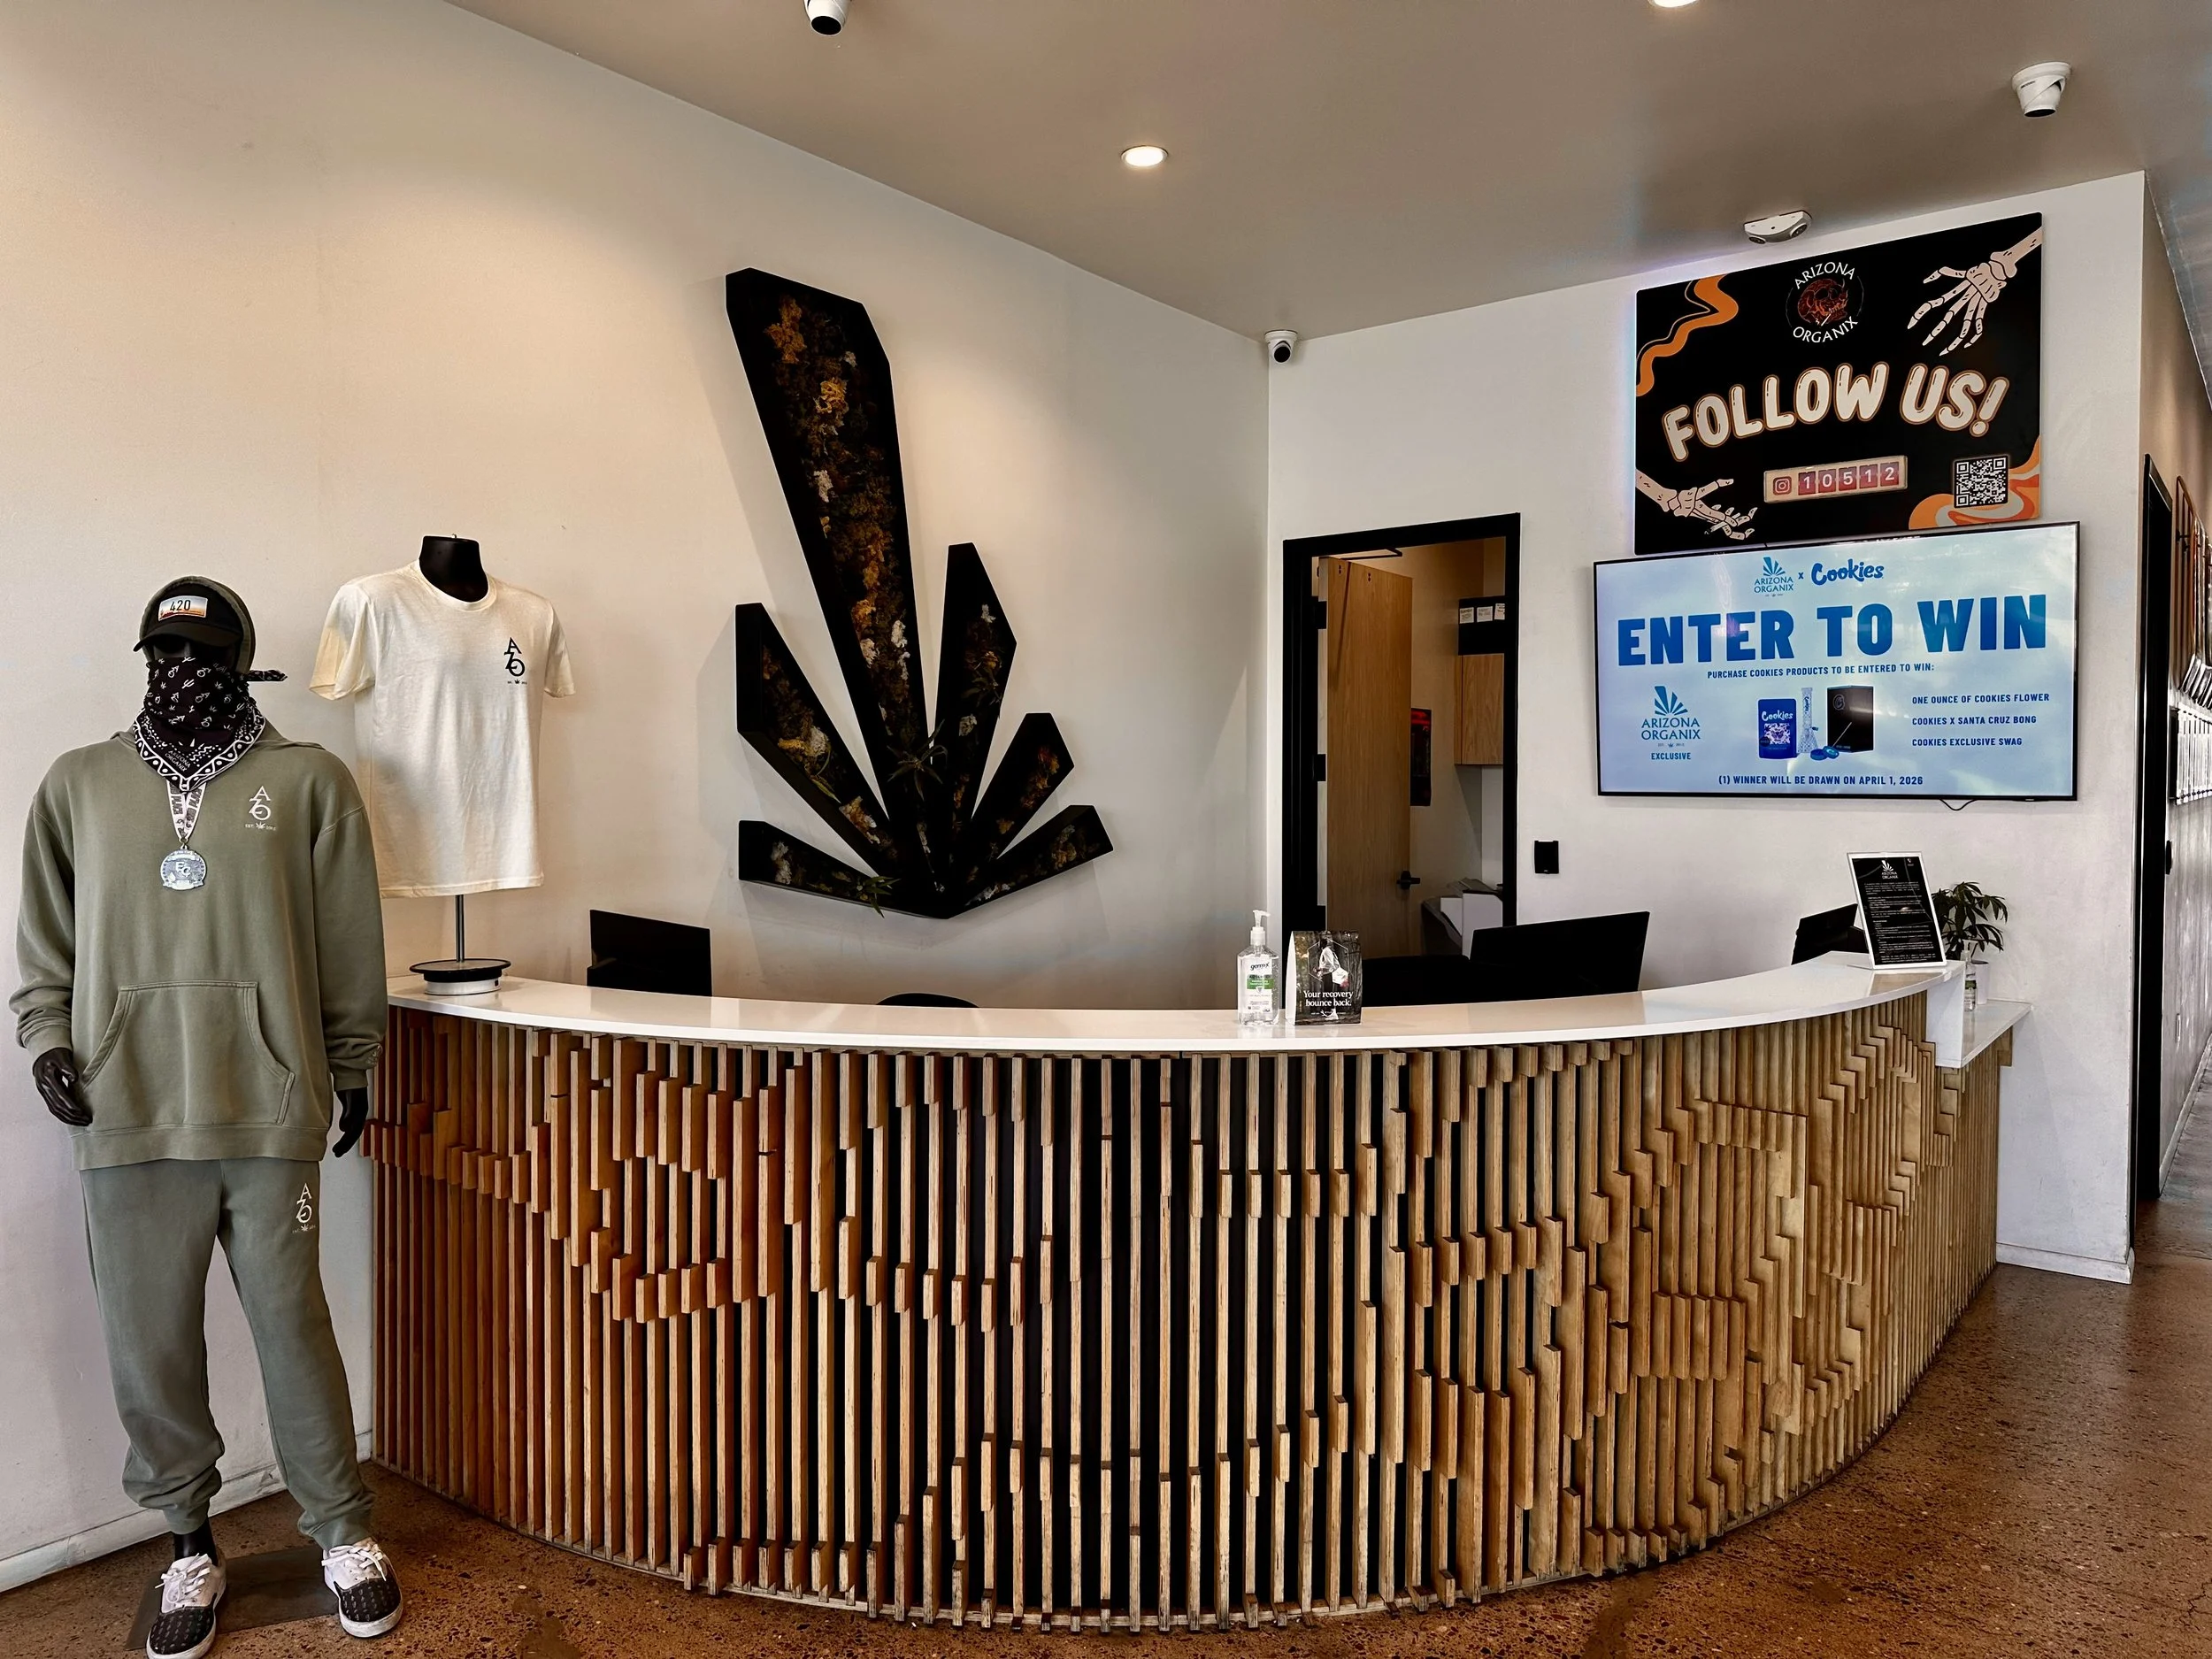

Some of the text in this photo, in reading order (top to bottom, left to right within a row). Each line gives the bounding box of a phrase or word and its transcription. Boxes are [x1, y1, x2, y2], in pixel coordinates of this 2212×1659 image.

[1794, 261, 1855, 289] ARIZONA
[1793, 316, 1858, 342] ORGANIX
[1662, 361, 2009, 462] FOLLOW US!
[1802, 466, 1895, 489] 10512
[1811, 558, 1885, 586] Cookies
[1754, 577, 1794, 586] ARIZONA
[1754, 584, 1794, 594] ORGANIX
[170, 599, 191, 611] 420
[1617, 594, 2047, 666] ENTER TO WIN
[1707, 670, 1747, 679] PURCHASE
[1749, 668, 1784, 677] COOKIES
[1786, 666, 1829, 676] PRODUCTS
[1831, 665, 1842, 674] TO
[1857, 664, 1897, 673] ENTERED
[1914, 663, 1935, 672] WIN:
[1974, 694, 2011, 703] COOKIES
[2013, 693, 2050, 702] FLOWER
[1762, 710, 1793, 722] Cookies
[1912, 717, 1947, 726] COOKIES
[1957, 716, 1985, 725] SANTA
[2013, 715, 2037, 724] BONG
[1641, 718, 1701, 728] ARIZONA
[1641, 729, 1701, 741] ORGANIX
[1912, 738, 1947, 747] COOKIES
[1999, 737, 2023, 746] SWAG
[1718, 775, 1924, 786] (1) WINNER WILL BE DRAWN ON APRIL 1, 2026
[1333, 997, 1352, 1007] back.
